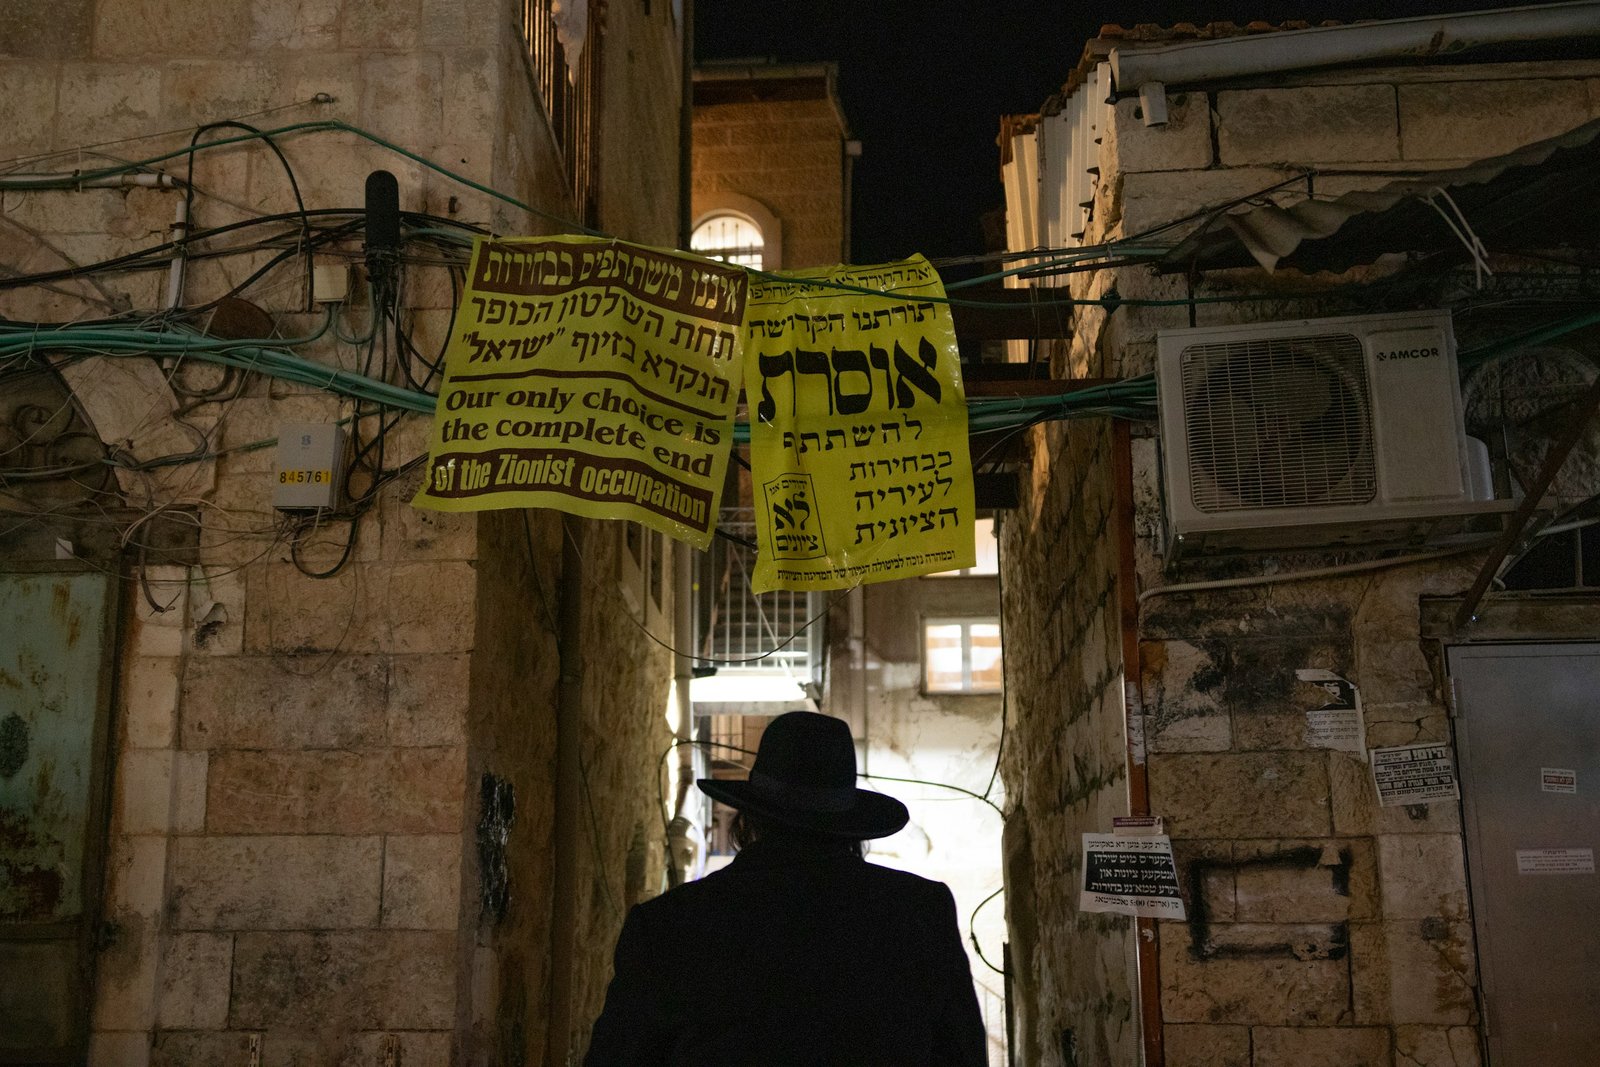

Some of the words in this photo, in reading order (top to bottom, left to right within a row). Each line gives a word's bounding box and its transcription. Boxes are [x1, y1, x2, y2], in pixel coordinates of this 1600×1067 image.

[484, 248, 573, 288] בבחירות
[471, 296, 554, 326] הכופר
[557, 286, 665, 338] השלטון
[691, 268, 742, 316] איננו
[748, 312, 845, 344] הקדושה
[852, 302, 937, 332] תורתנו
[570, 328, 637, 364] בזיוף
[670, 318, 736, 361] תחת
[1389, 348, 1439, 360] AMCOR
[641, 350, 731, 404] הנקרא
[757, 335, 943, 424] אוסרת
[445, 389, 500, 412] Our
[506, 387, 576, 415] only
[582, 388, 684, 435] choice
[692, 420, 721, 446] is
[441, 417, 488, 443] the
[495, 418, 646, 451] complete
[653, 447, 714, 479] end
[783, 412, 923, 466] להשתתף
[279, 472, 329, 484] 845761
[848, 450, 953, 482] בבחירות
[434, 457, 456, 493] of
[460, 458, 491, 490] the
[494, 453, 576, 488] Zionist
[579, 465, 707, 525] occupation
[854, 469, 954, 513] לעיריה
[772, 490, 811, 533] לא
[854, 506, 959, 546] הציונית
[775, 533, 819, 552] ציונים
